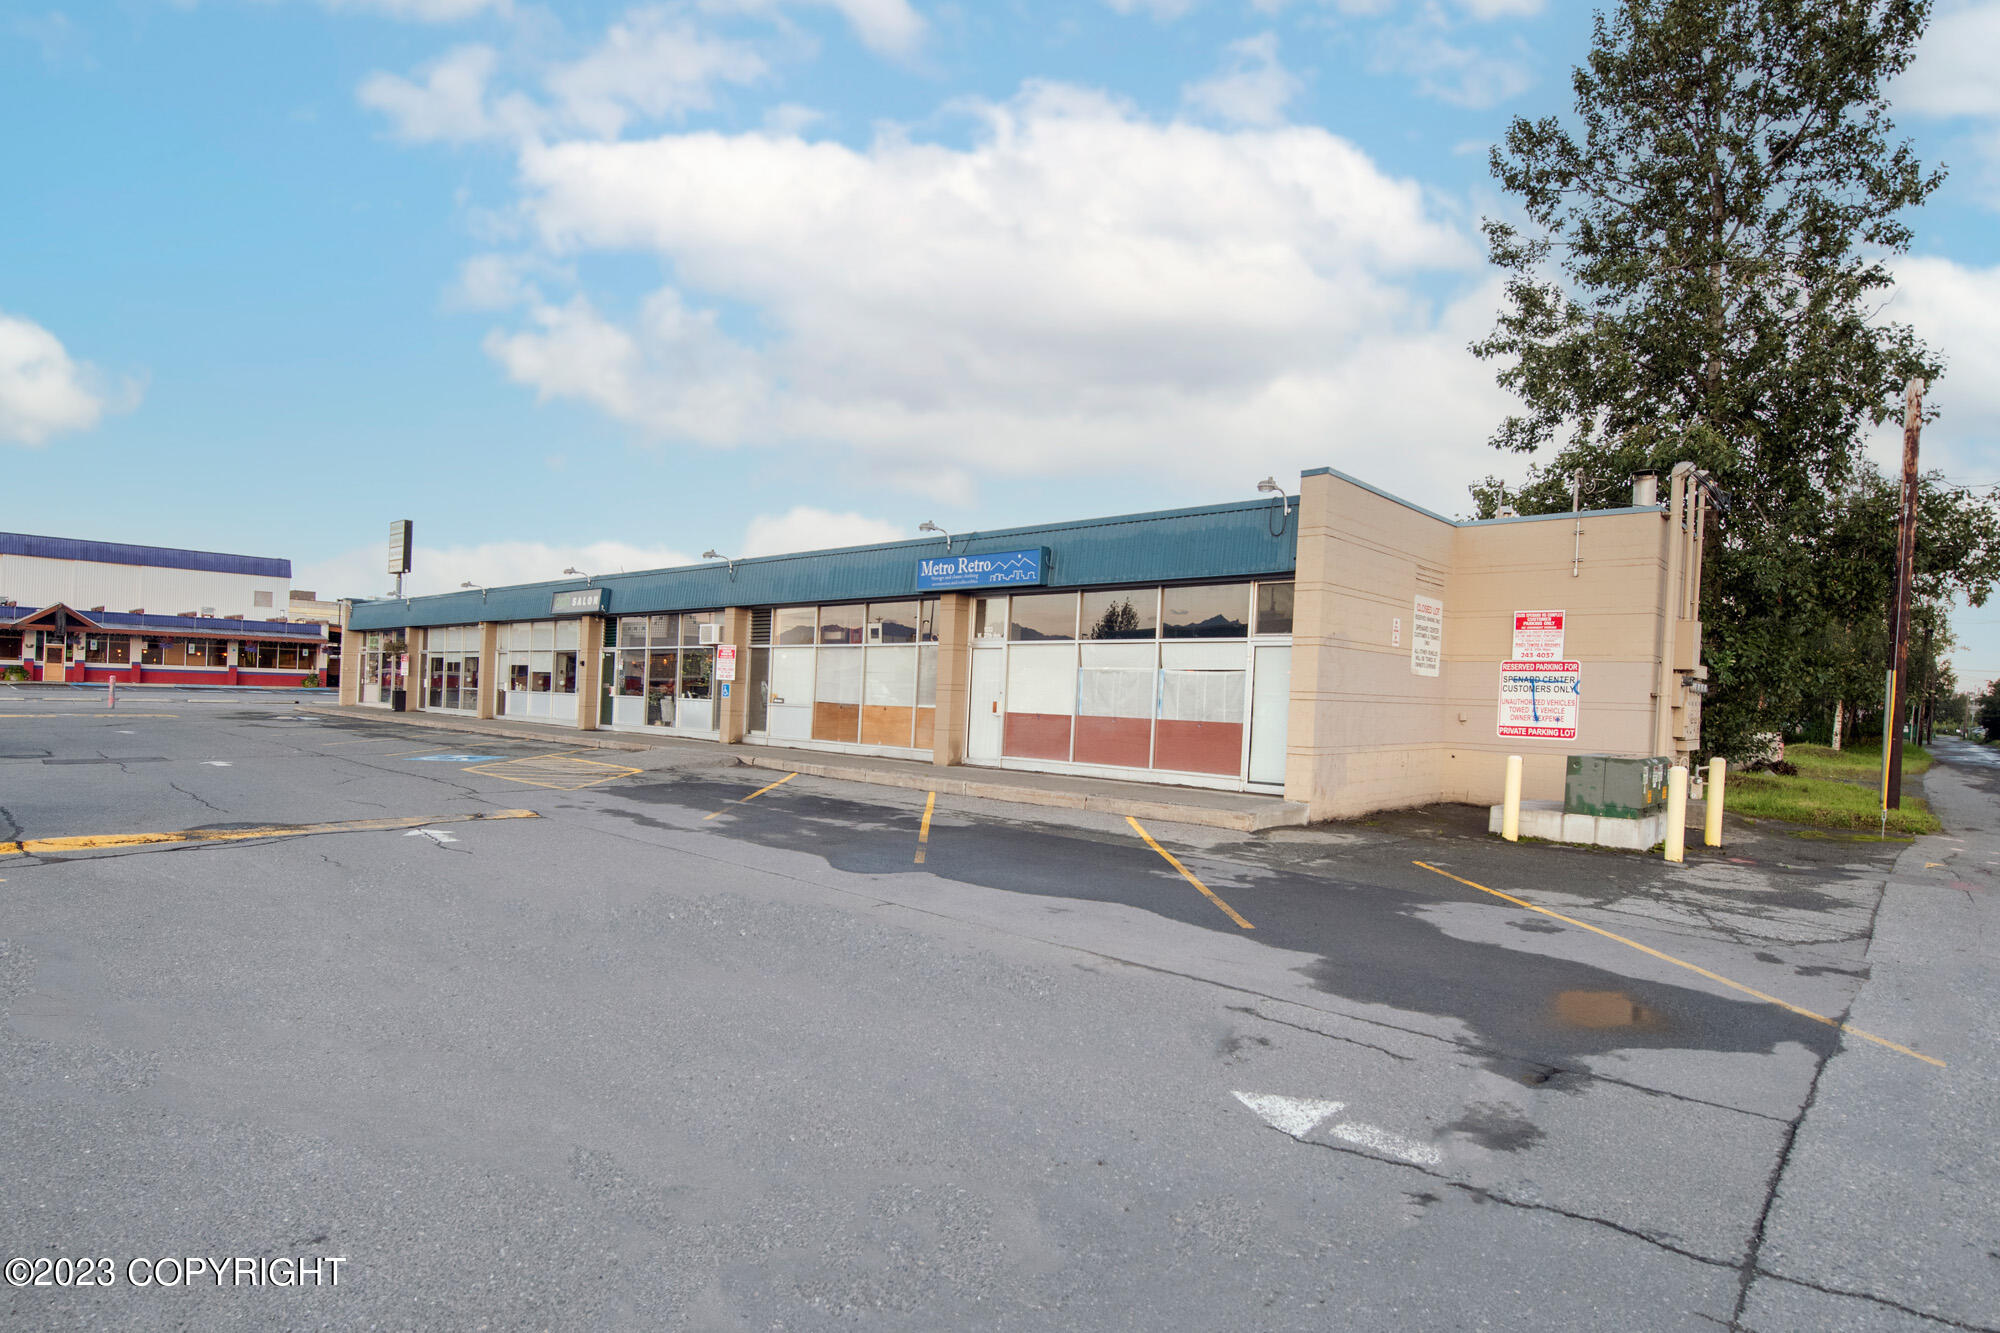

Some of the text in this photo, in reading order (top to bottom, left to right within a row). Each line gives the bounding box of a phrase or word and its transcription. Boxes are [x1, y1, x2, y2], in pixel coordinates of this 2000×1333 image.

[921, 557, 992, 577] Metro Retro
[572, 595, 599, 607] SALON
[1502, 663, 1535, 671] RESERVED
[1536, 663, 1563, 671] PARKING
[1503, 675, 1576, 684] SPENARD CENTER
[1502, 685, 1576, 693] CUSTOMERS ONLY
[1502, 698, 1545, 706] UNAUTHORZED
[1499, 727, 1576, 737] PRIVATE PARKING LOT
